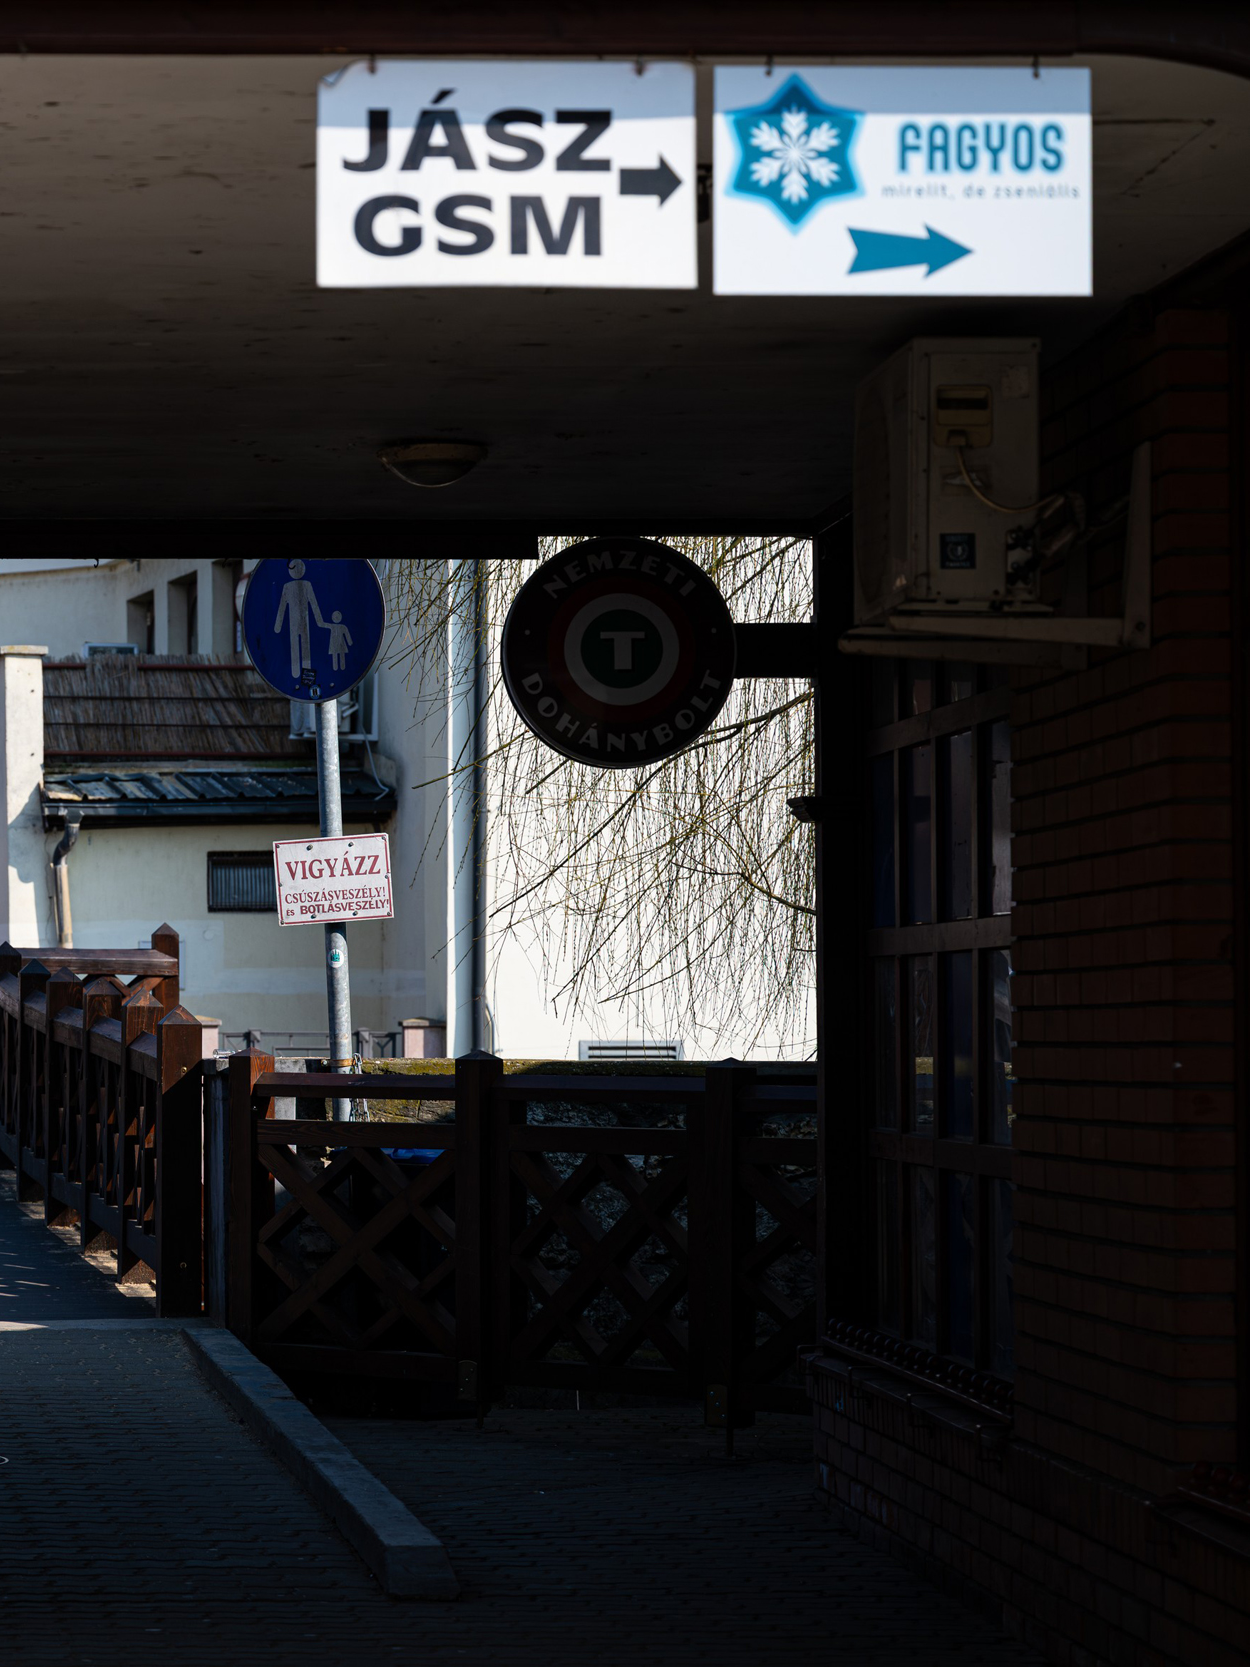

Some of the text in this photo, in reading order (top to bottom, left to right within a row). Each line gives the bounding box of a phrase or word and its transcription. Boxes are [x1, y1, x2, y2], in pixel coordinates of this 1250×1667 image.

[343, 88, 612, 172] JÁSZ
[900, 124, 1062, 171] FAGYOS
[962, 181, 986, 199] de
[354, 195, 602, 257] GSM
[542, 550, 697, 599] NEMZETI
[600, 631, 645, 670] T
[521, 669, 721, 752] DOHÁNYBOLT
[285, 851, 381, 880] VIGYÁZZ
[285, 885, 386, 904] CSÚSZÁSVESZÉLY!
[300, 899, 389, 915] BOTLÁSVESZÉLY!
